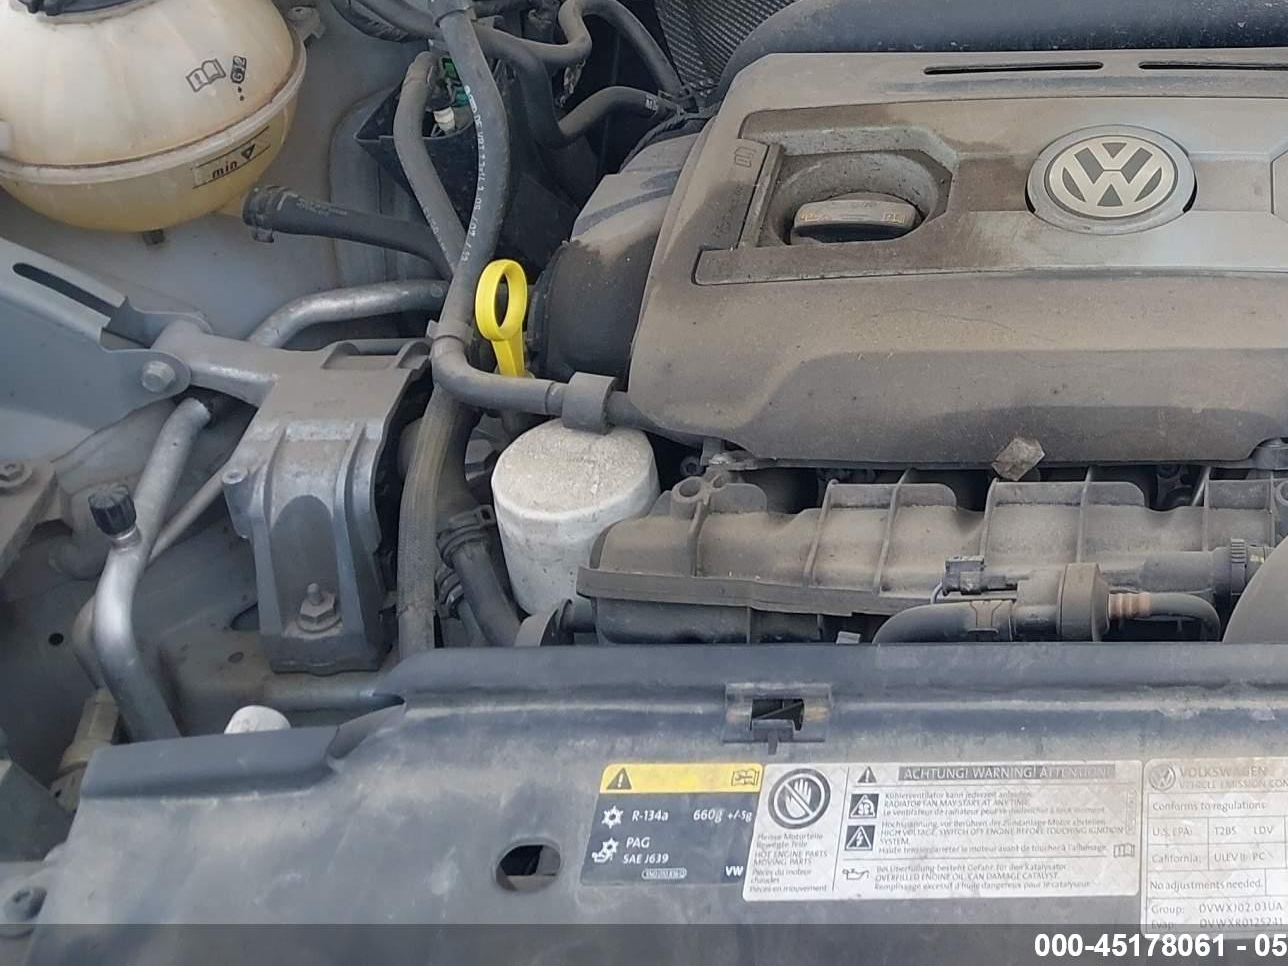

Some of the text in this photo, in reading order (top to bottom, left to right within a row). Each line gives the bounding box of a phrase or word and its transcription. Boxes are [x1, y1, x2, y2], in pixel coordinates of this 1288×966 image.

[212, 160, 238, 178] min
[904, 767, 968, 779] ACHTUNG!
[973, 765, 1036, 778] WARNING!
[1179, 765, 1269, 778] VOLKSWEN
[1152, 801, 1198, 811] Conforms
[1200, 801, 1211, 810] to
[632, 809, 669, 822] R-134a
[1252, 824, 1274, 835] LDV
[626, 836, 651, 849] PAG
[623, 852, 669, 864] SAE J639
[724, 865, 744, 877] VW
[1150, 880, 1164, 890] No
[1165, 879, 1225, 894] adjustments
[1151, 903, 1186, 916] Group:
